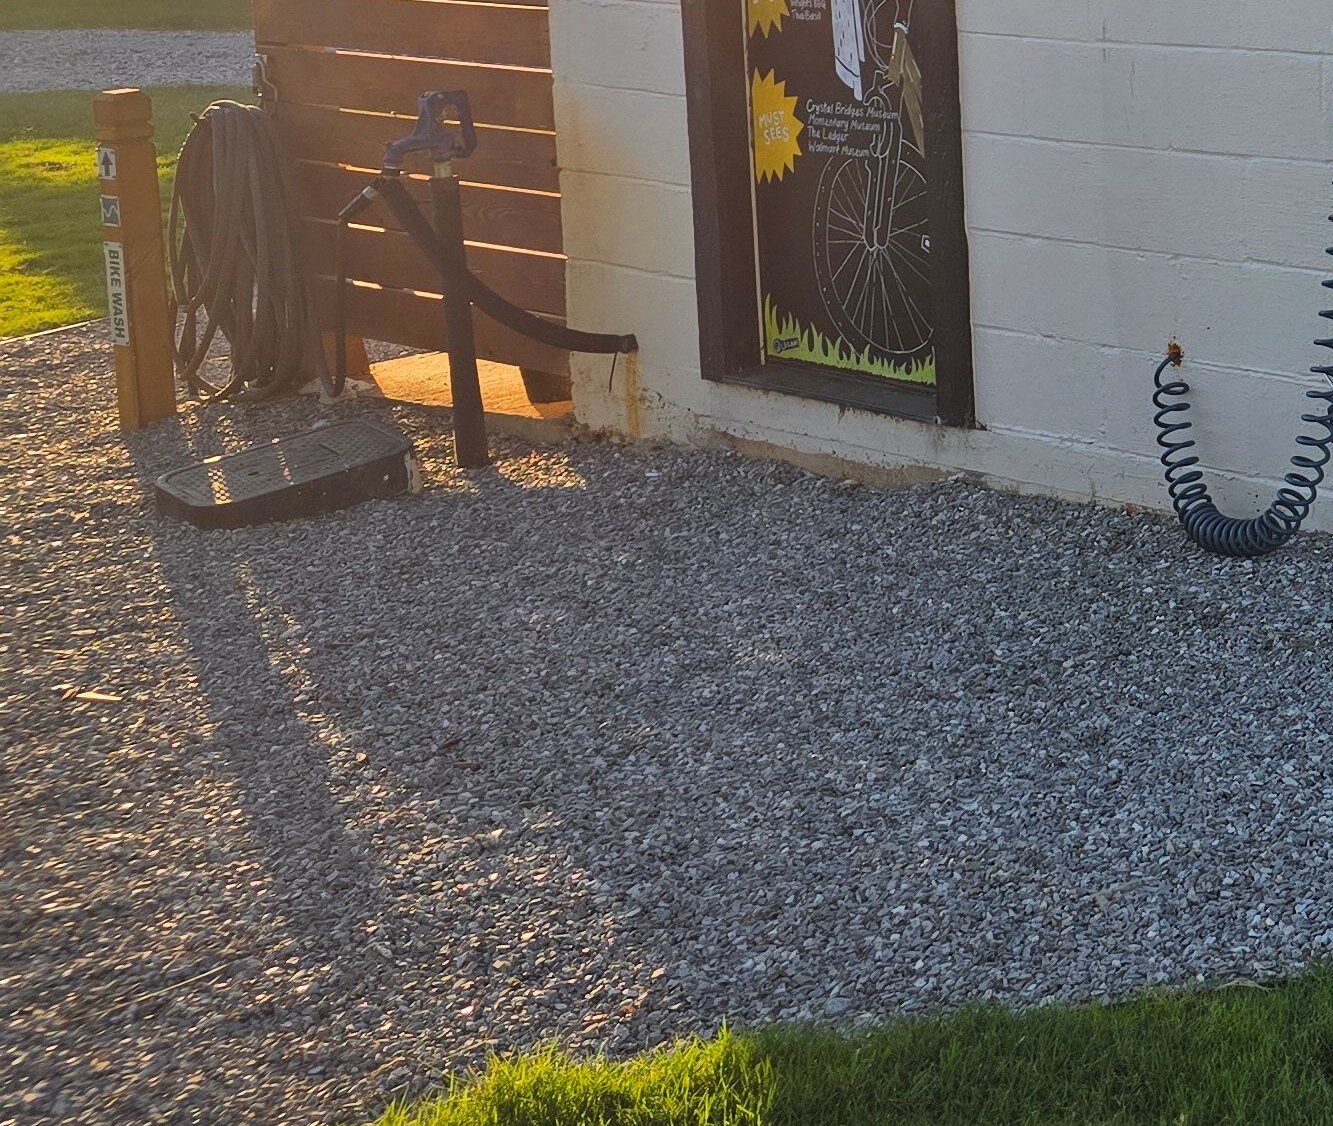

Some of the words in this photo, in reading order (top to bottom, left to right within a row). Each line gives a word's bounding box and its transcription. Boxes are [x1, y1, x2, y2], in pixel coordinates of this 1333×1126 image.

[806, 98, 834, 115] Crystal
[835, 101, 864, 117] Bridges
[865, 106, 900, 120] Museum
[758, 110, 785, 128] MUST
[849, 119, 881, 132] Museum
[763, 126, 791, 146] SEES
[807, 125, 821, 139] The
[822, 127, 849, 144] Ledger
[808, 140, 840, 154] Walmart
[841, 145, 870, 158] Museum
[108, 249, 122, 288] BIKE
[111, 293, 126, 339] WASH
